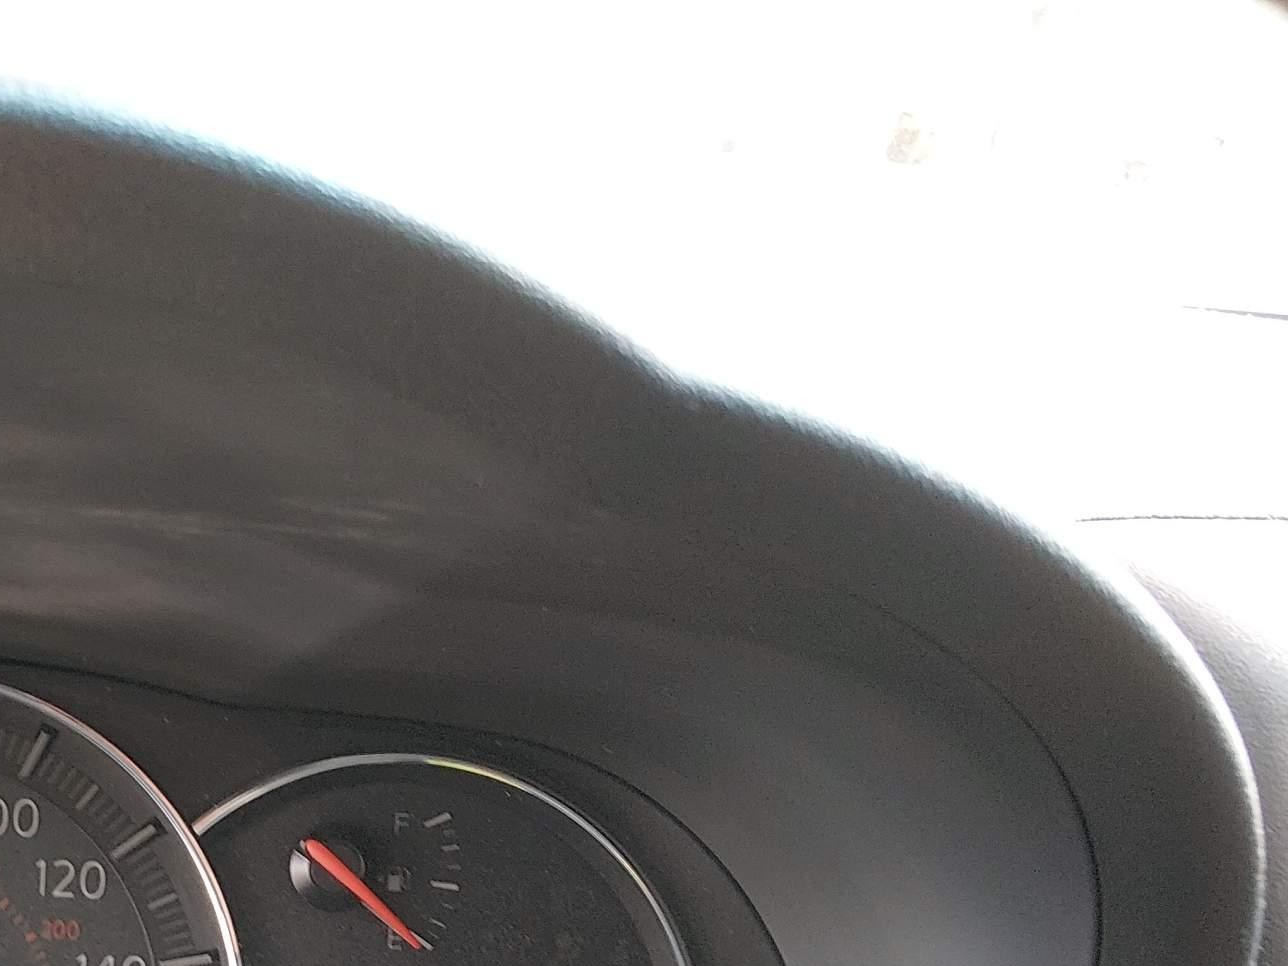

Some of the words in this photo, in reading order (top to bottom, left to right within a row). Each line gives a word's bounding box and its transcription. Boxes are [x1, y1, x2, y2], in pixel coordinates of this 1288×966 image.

[394, 812, 410, 834] F
[35, 860, 106, 900] 120
[41, 920, 80, 940] 200
